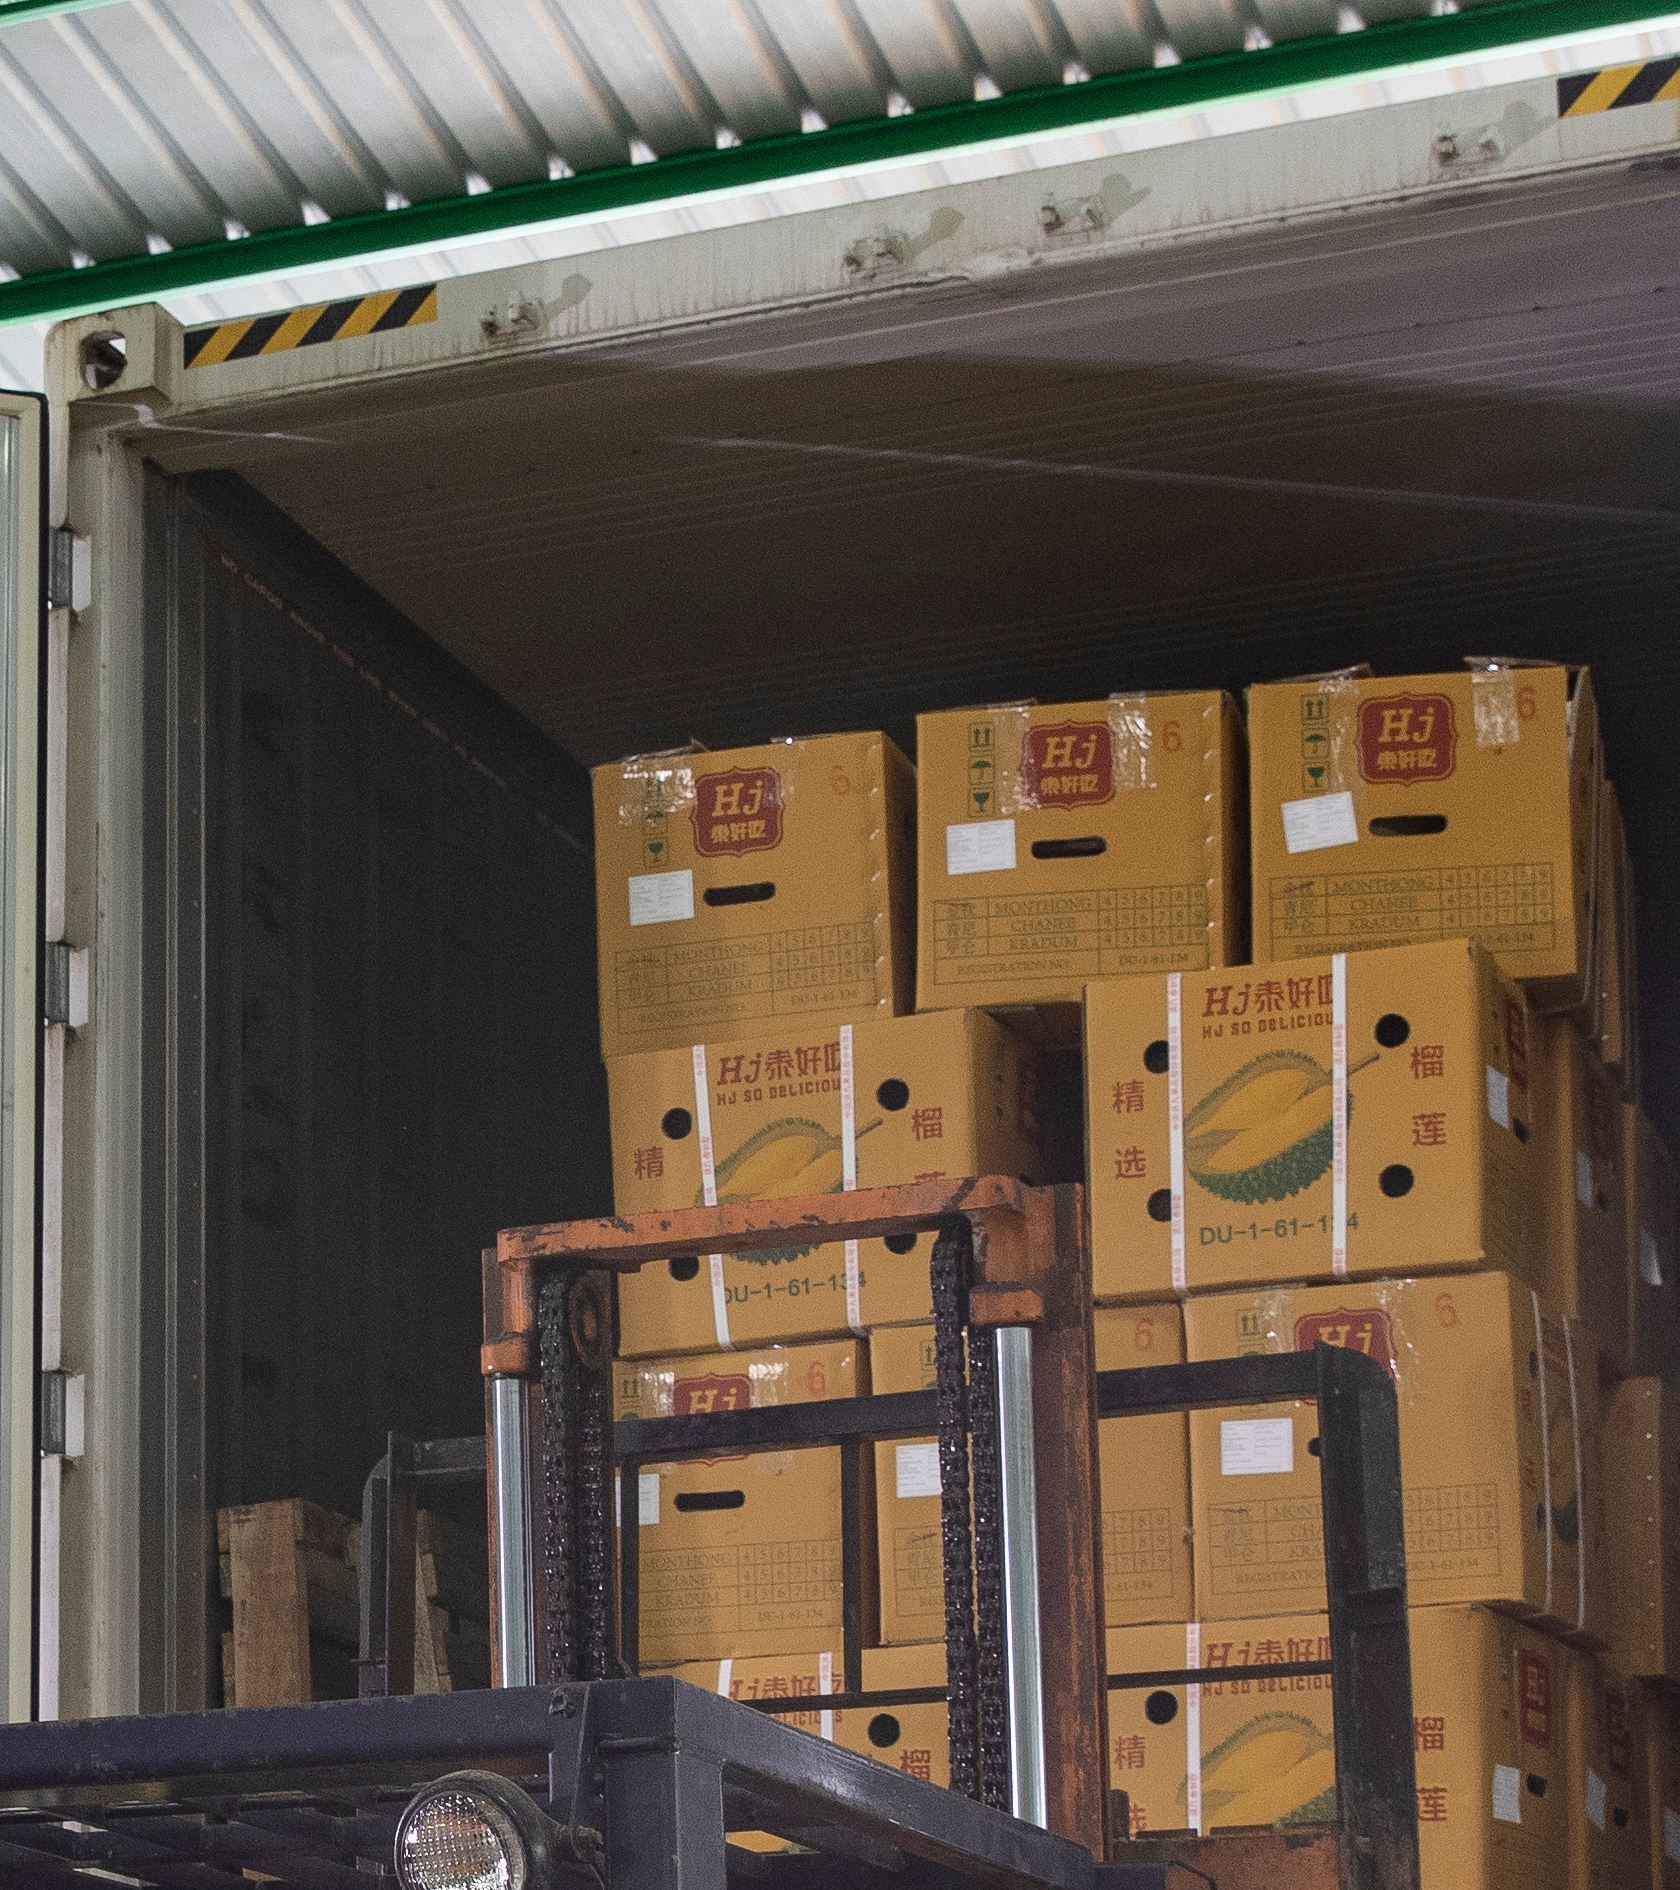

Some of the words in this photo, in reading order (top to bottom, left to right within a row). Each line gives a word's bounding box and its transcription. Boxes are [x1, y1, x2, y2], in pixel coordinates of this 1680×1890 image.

[1161, 719, 1183, 751] 6
[1377, 706, 1435, 743] Hj
[1041, 734, 1098, 770] Hj
[712, 779, 763, 817] Hj
[1258, 1012, 1333, 1033] DELICIOU
[768, 1077, 840, 1100] DELICIOU
[1199, 1213, 1359, 1247] DU-1-61-14
[723, 1270, 868, 1305] DU-1-61-14
